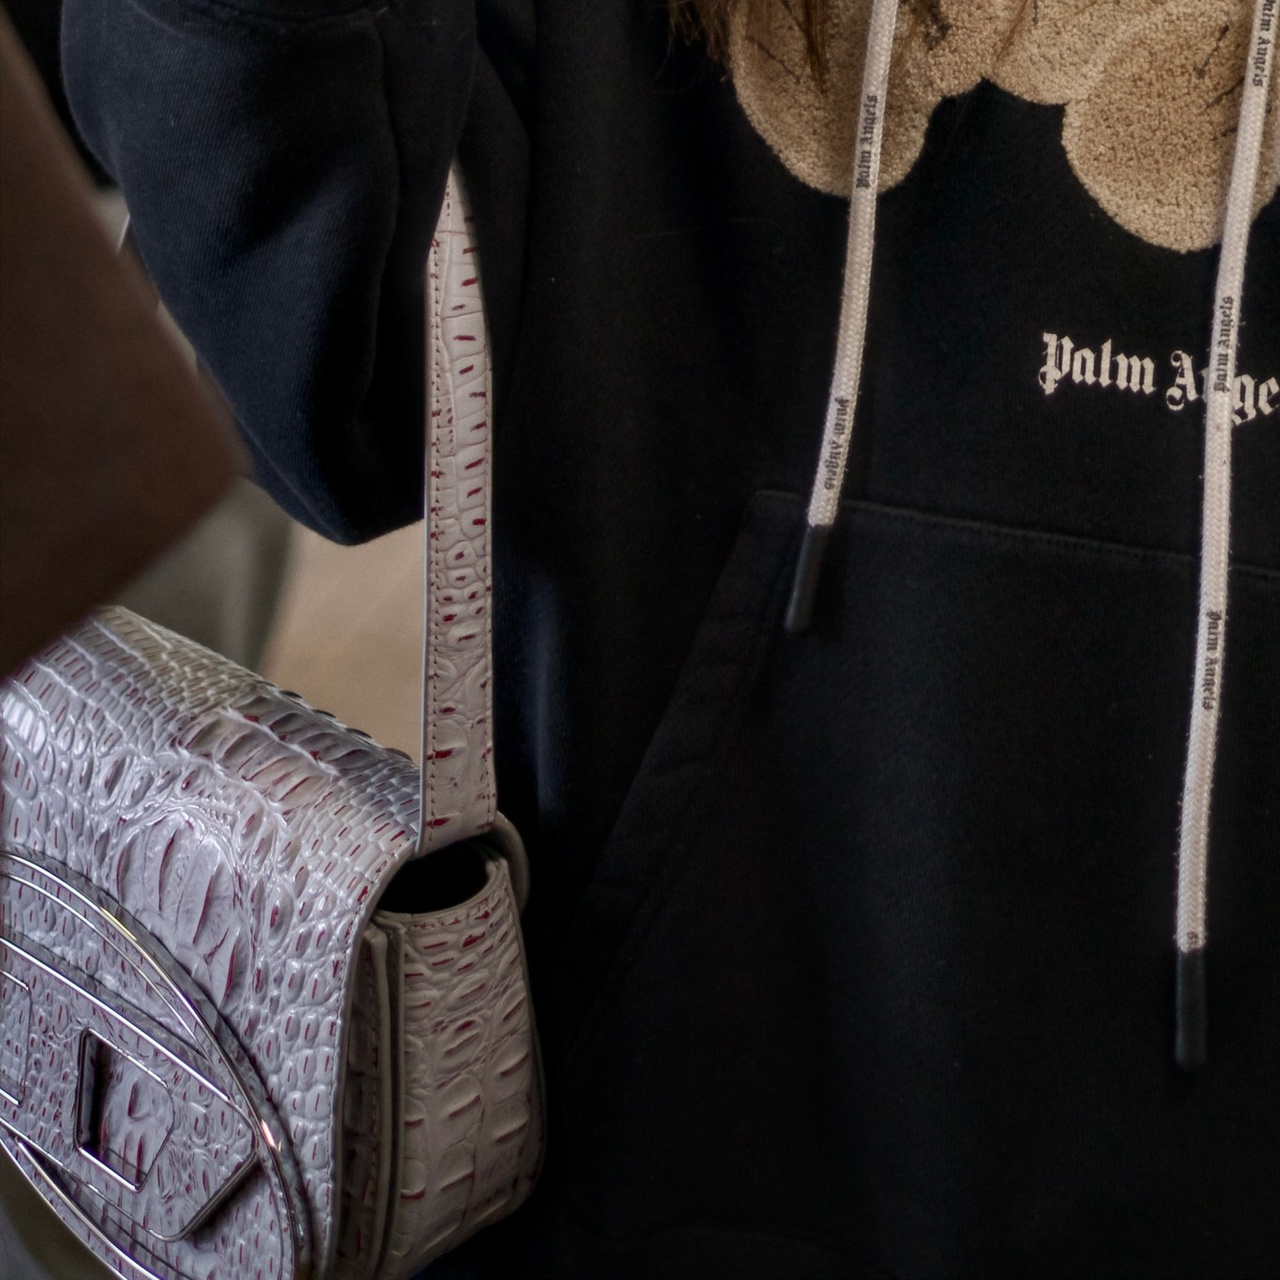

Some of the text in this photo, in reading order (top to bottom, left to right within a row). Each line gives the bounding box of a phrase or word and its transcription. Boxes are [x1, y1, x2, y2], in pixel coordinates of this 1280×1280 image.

[1252, 36, 1272, 88] Angels
[855, 93, 878, 189] Palm Angels
[1038, 331, 1157, 396] Palm
[1213, 295, 1234, 393] Palm Angels
[824, 397, 850, 491] Palm Angels
[1201, 609, 1222, 710] Palm Angels
